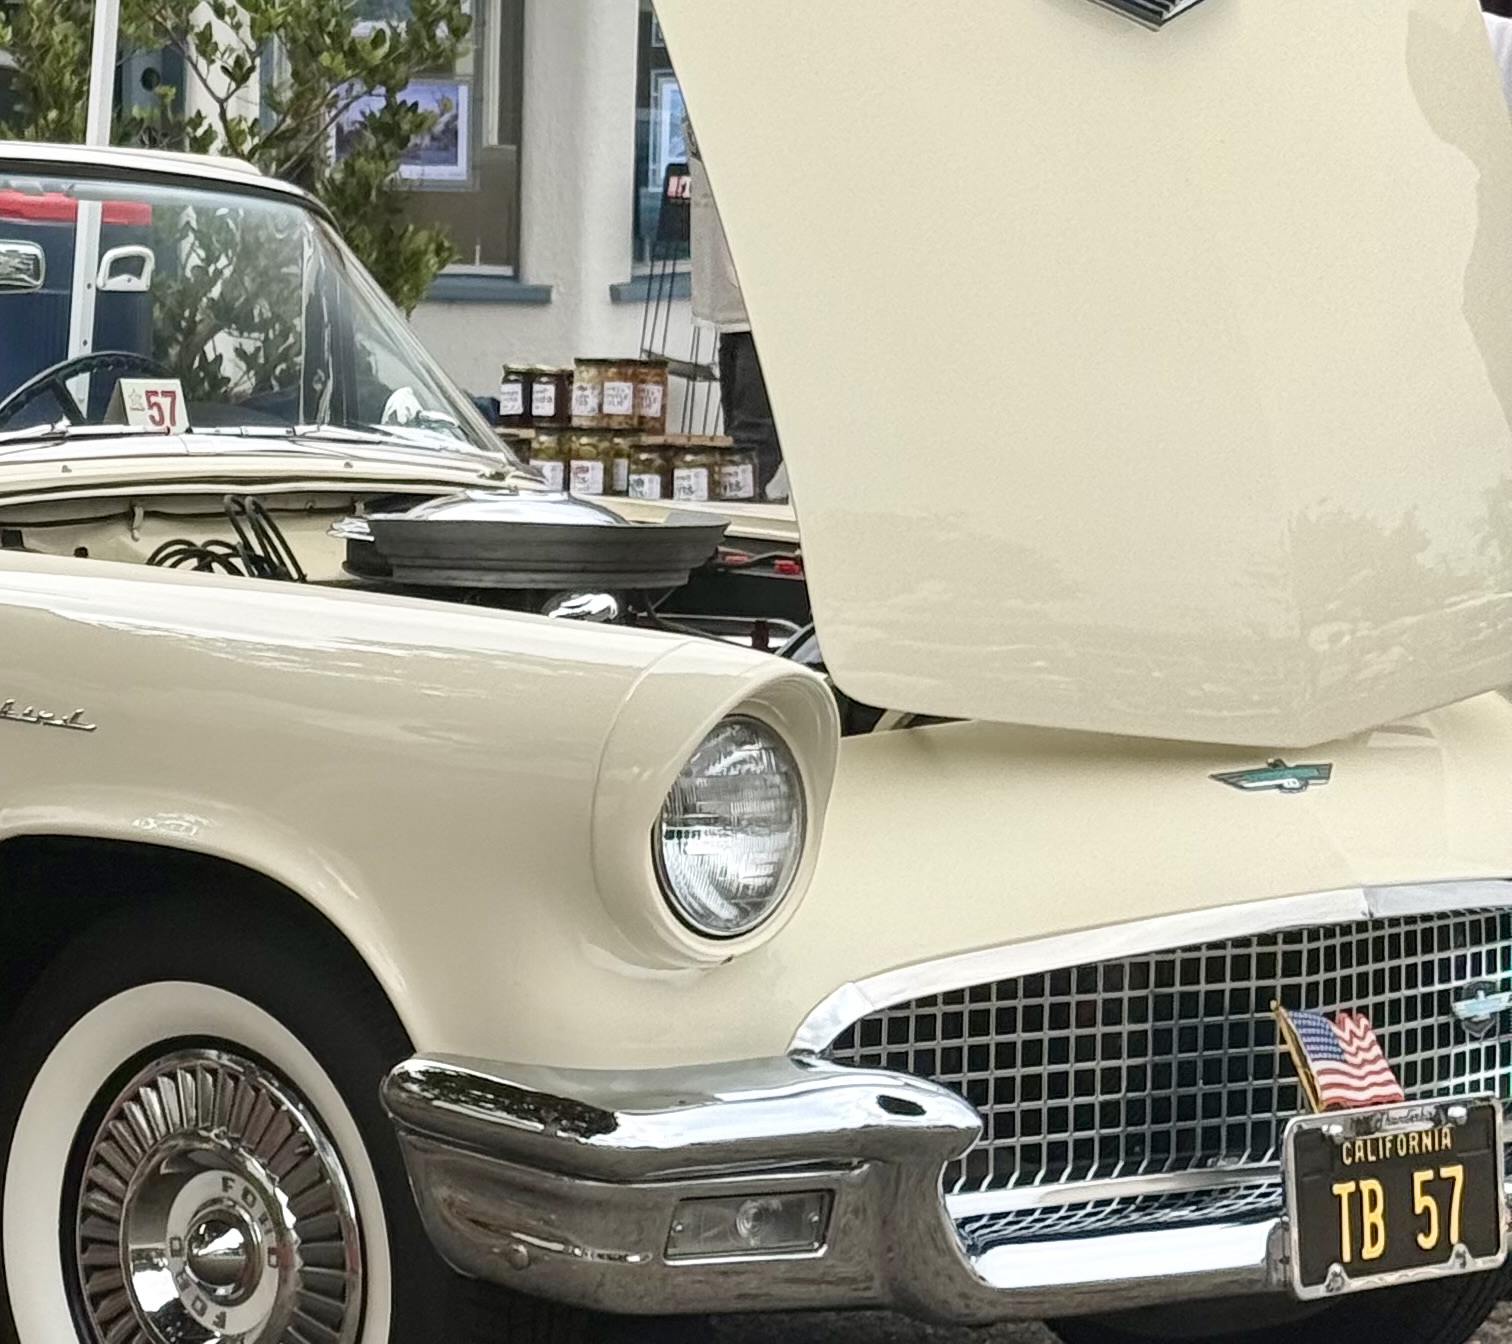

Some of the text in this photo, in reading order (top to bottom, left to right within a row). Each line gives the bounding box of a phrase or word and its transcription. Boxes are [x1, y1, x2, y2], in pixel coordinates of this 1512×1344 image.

[145, 389, 177, 427] 57
[1341, 1126, 1453, 1166] CALIFORNIA
[1332, 1164, 1465, 1264] TB 57
